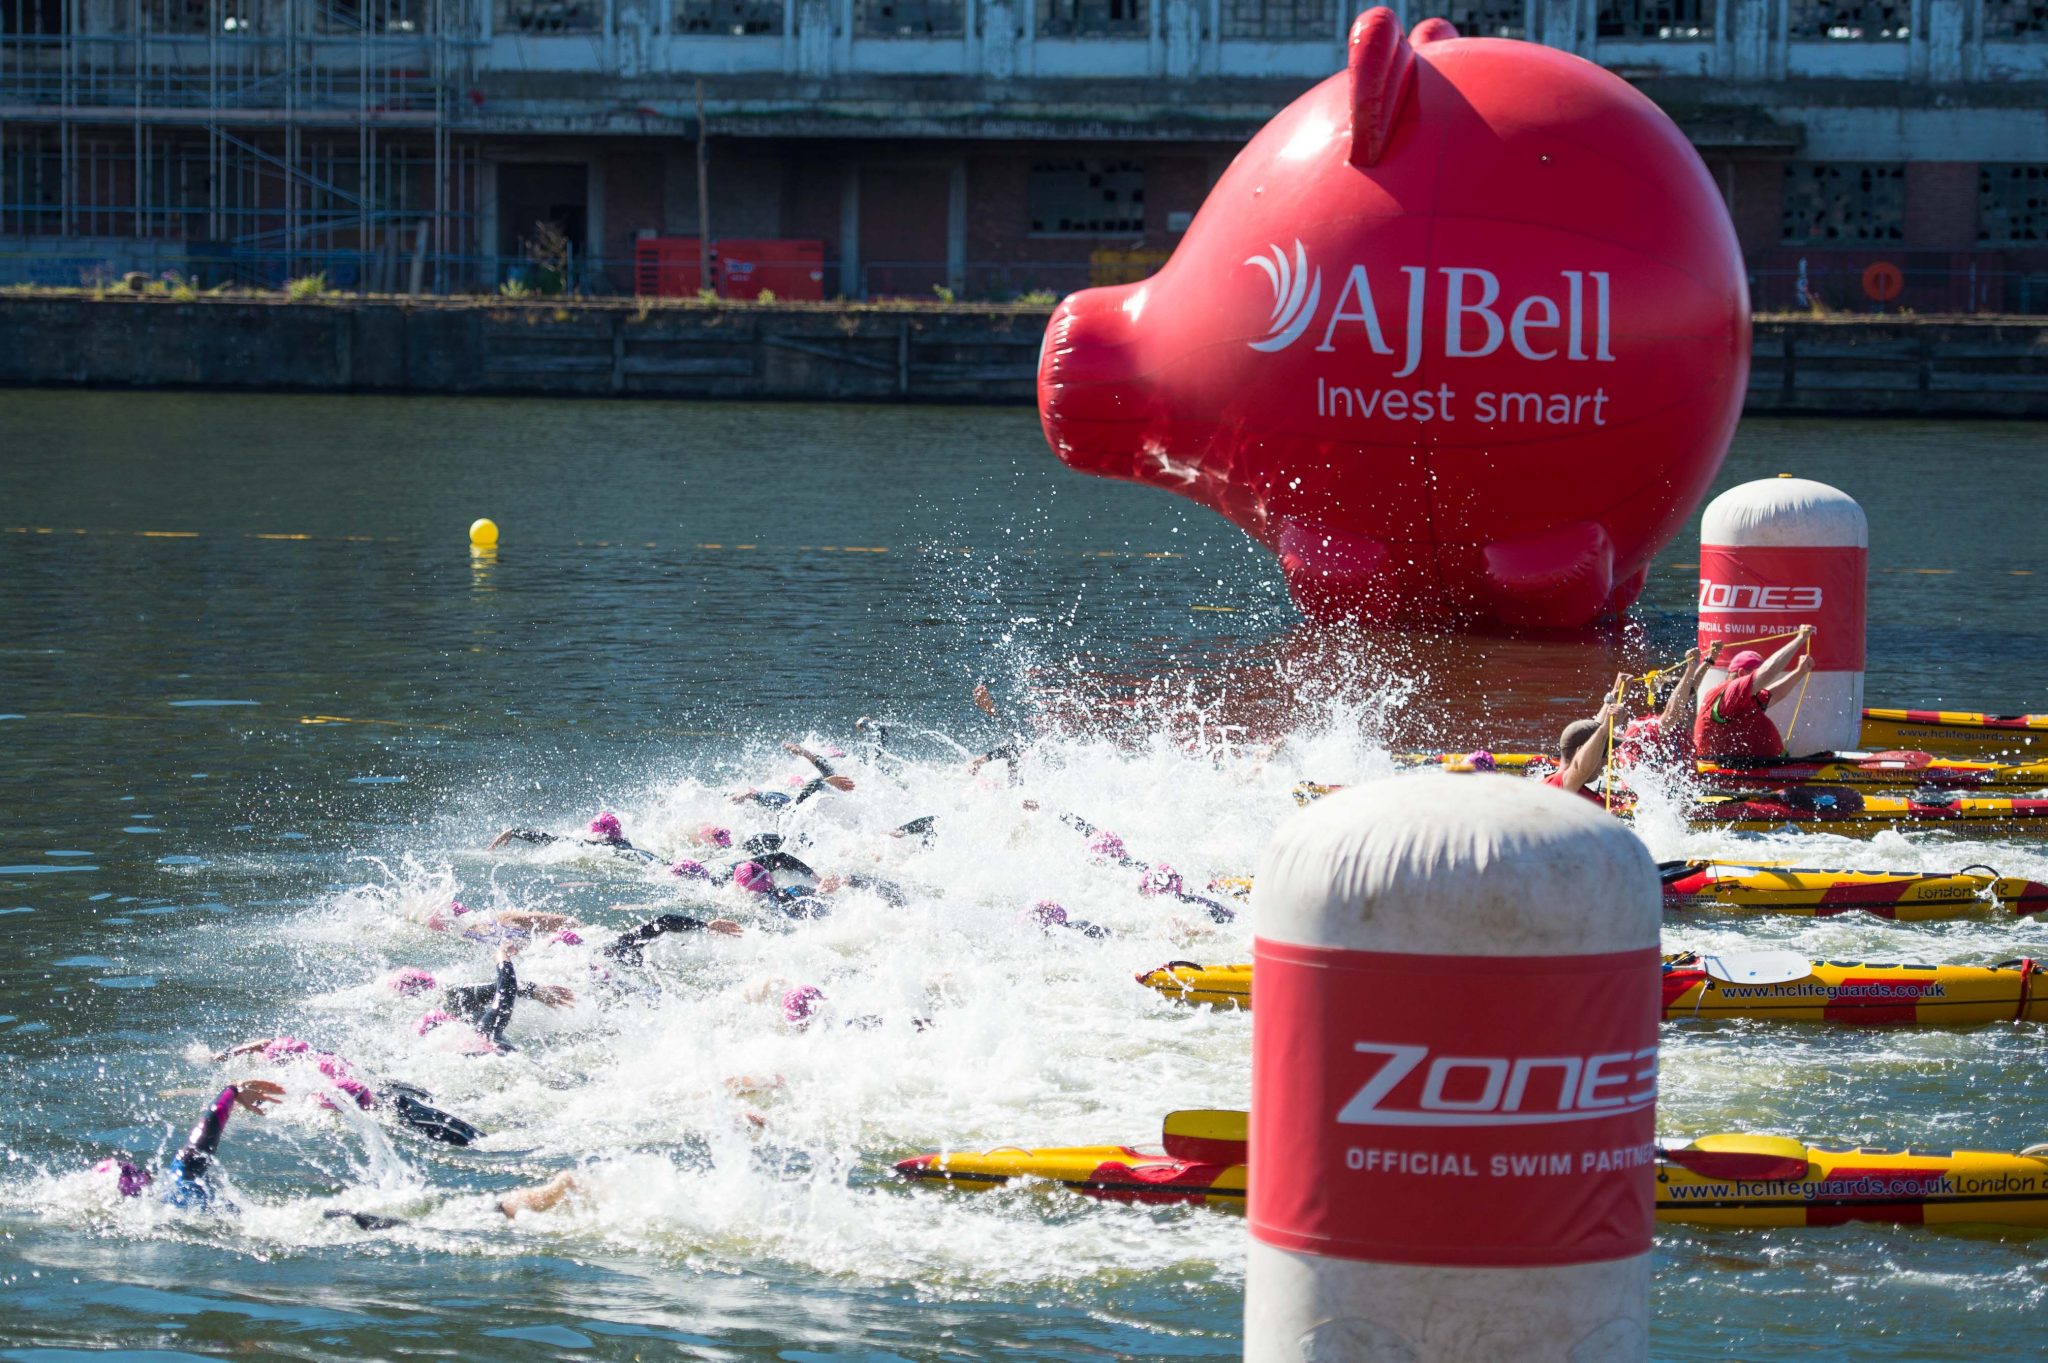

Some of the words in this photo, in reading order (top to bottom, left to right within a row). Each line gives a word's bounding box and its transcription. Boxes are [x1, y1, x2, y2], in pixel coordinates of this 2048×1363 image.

[1317, 378, 1456, 422] Invest
[1474, 387, 1609, 426] smart
[1725, 623, 1756, 634] SWIM
[1760, 624, 1818, 636] PARTNR
[1917, 886, 1971, 899] London
[1722, 983, 1946, 999] www.hclifeguards.co.uk
[1337, 1042, 1658, 1126] ZONE3
[1345, 1147, 1479, 1177] OFFICIAL
[1490, 1153, 1572, 1177] SWIM
[1668, 1175, 1953, 1200] www.hclifeguards.co.uk
[1956, 1173, 2036, 1194] London
